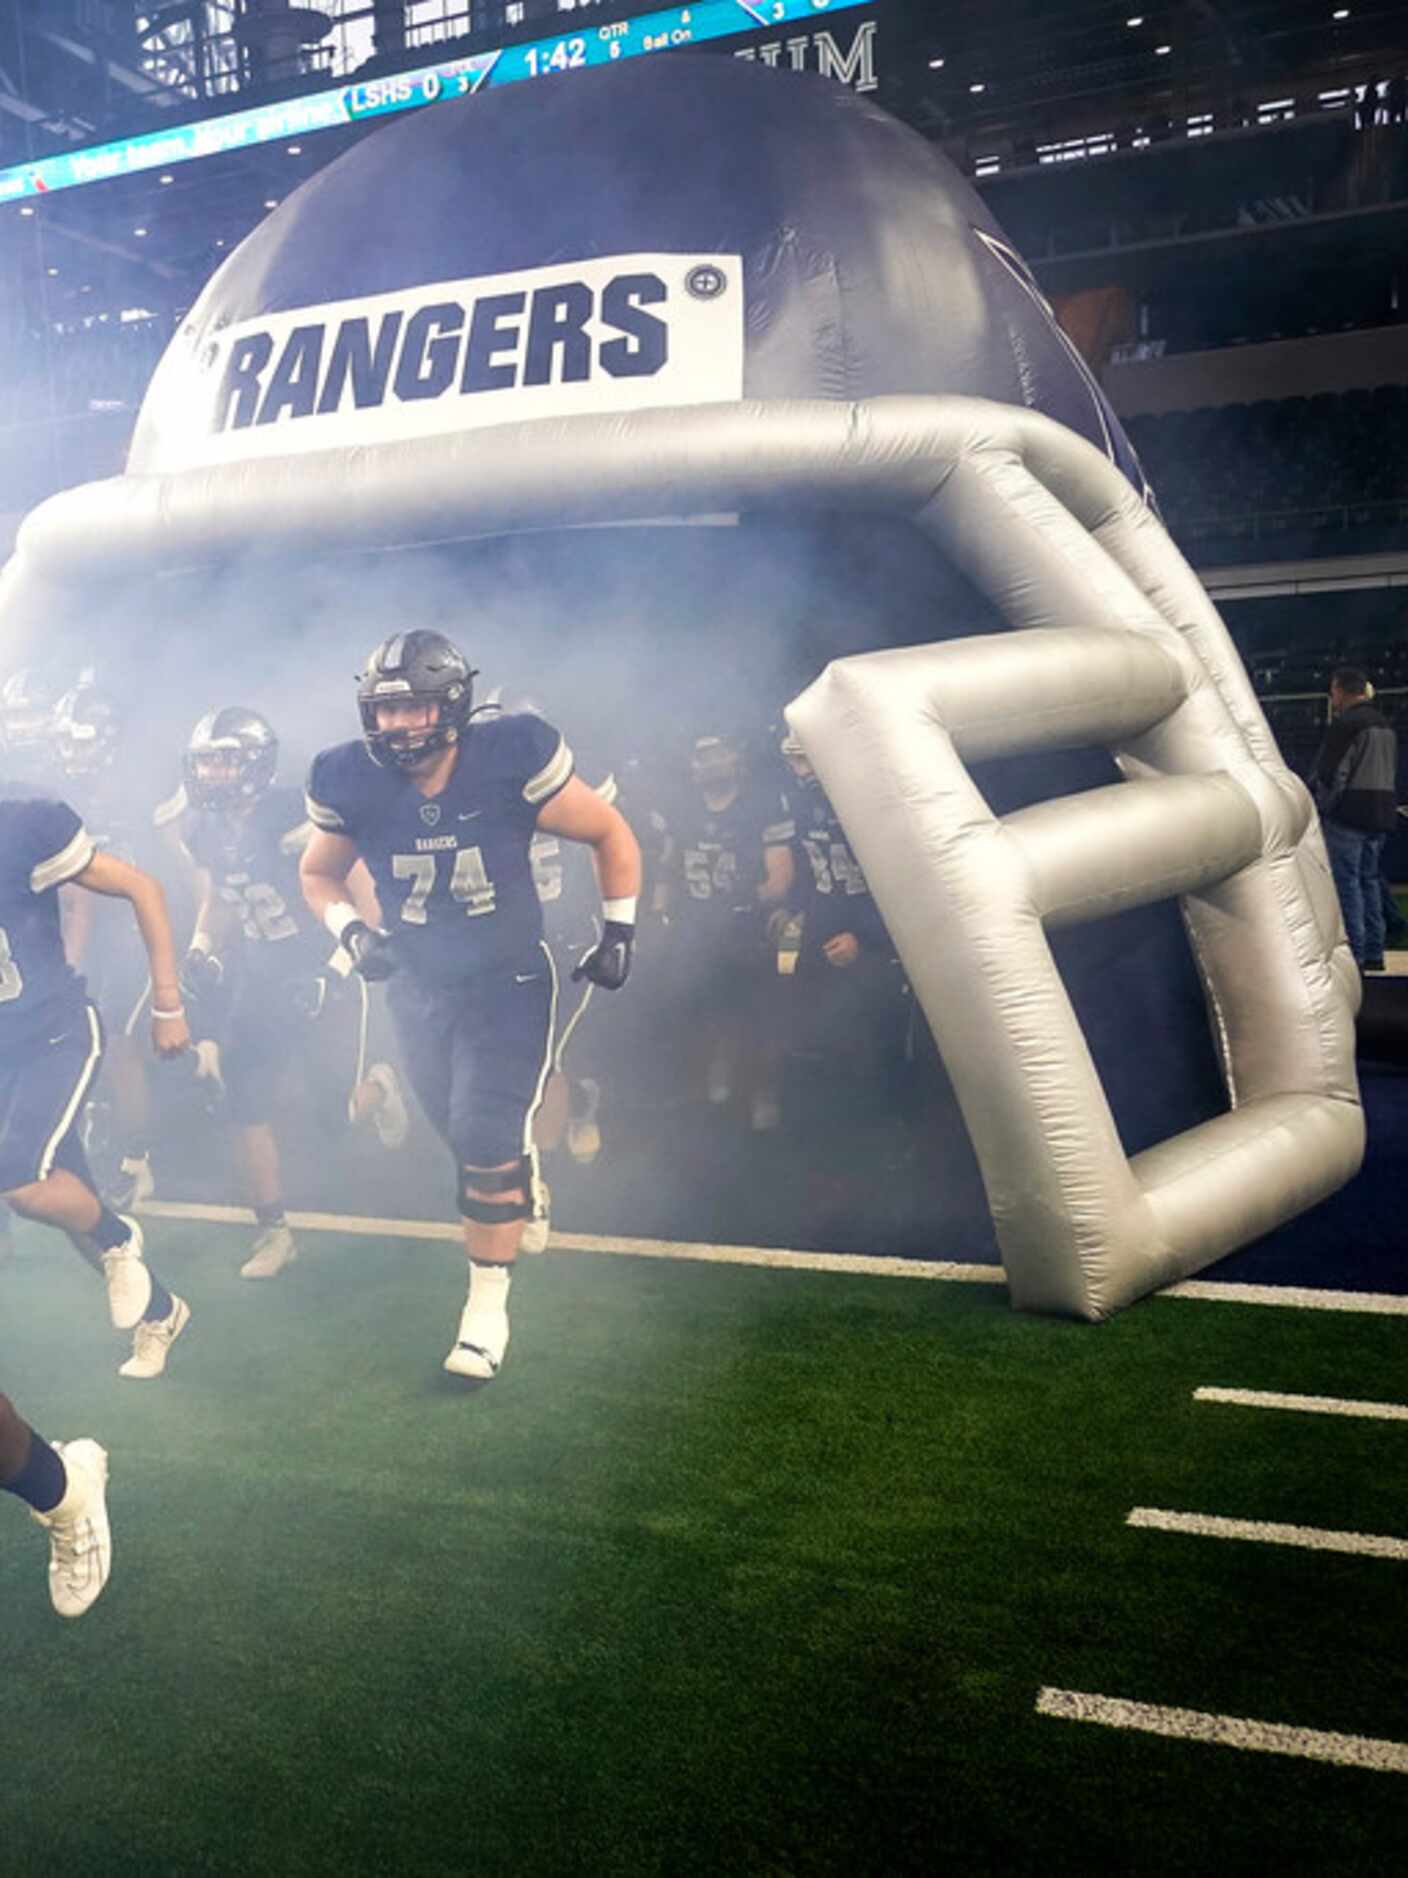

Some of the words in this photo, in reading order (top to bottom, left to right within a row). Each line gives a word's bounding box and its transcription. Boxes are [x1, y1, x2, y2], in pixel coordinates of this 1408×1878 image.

[599, 21, 629, 40] QTR
[525, 38, 587, 77] 1:42
[352, 81, 412, 112] LSHS
[422, 73, 441, 100] 0
[216, 273, 668, 432] RANGERS
[414, 834, 458, 851] RANGERS
[392, 846, 496, 925] 74
